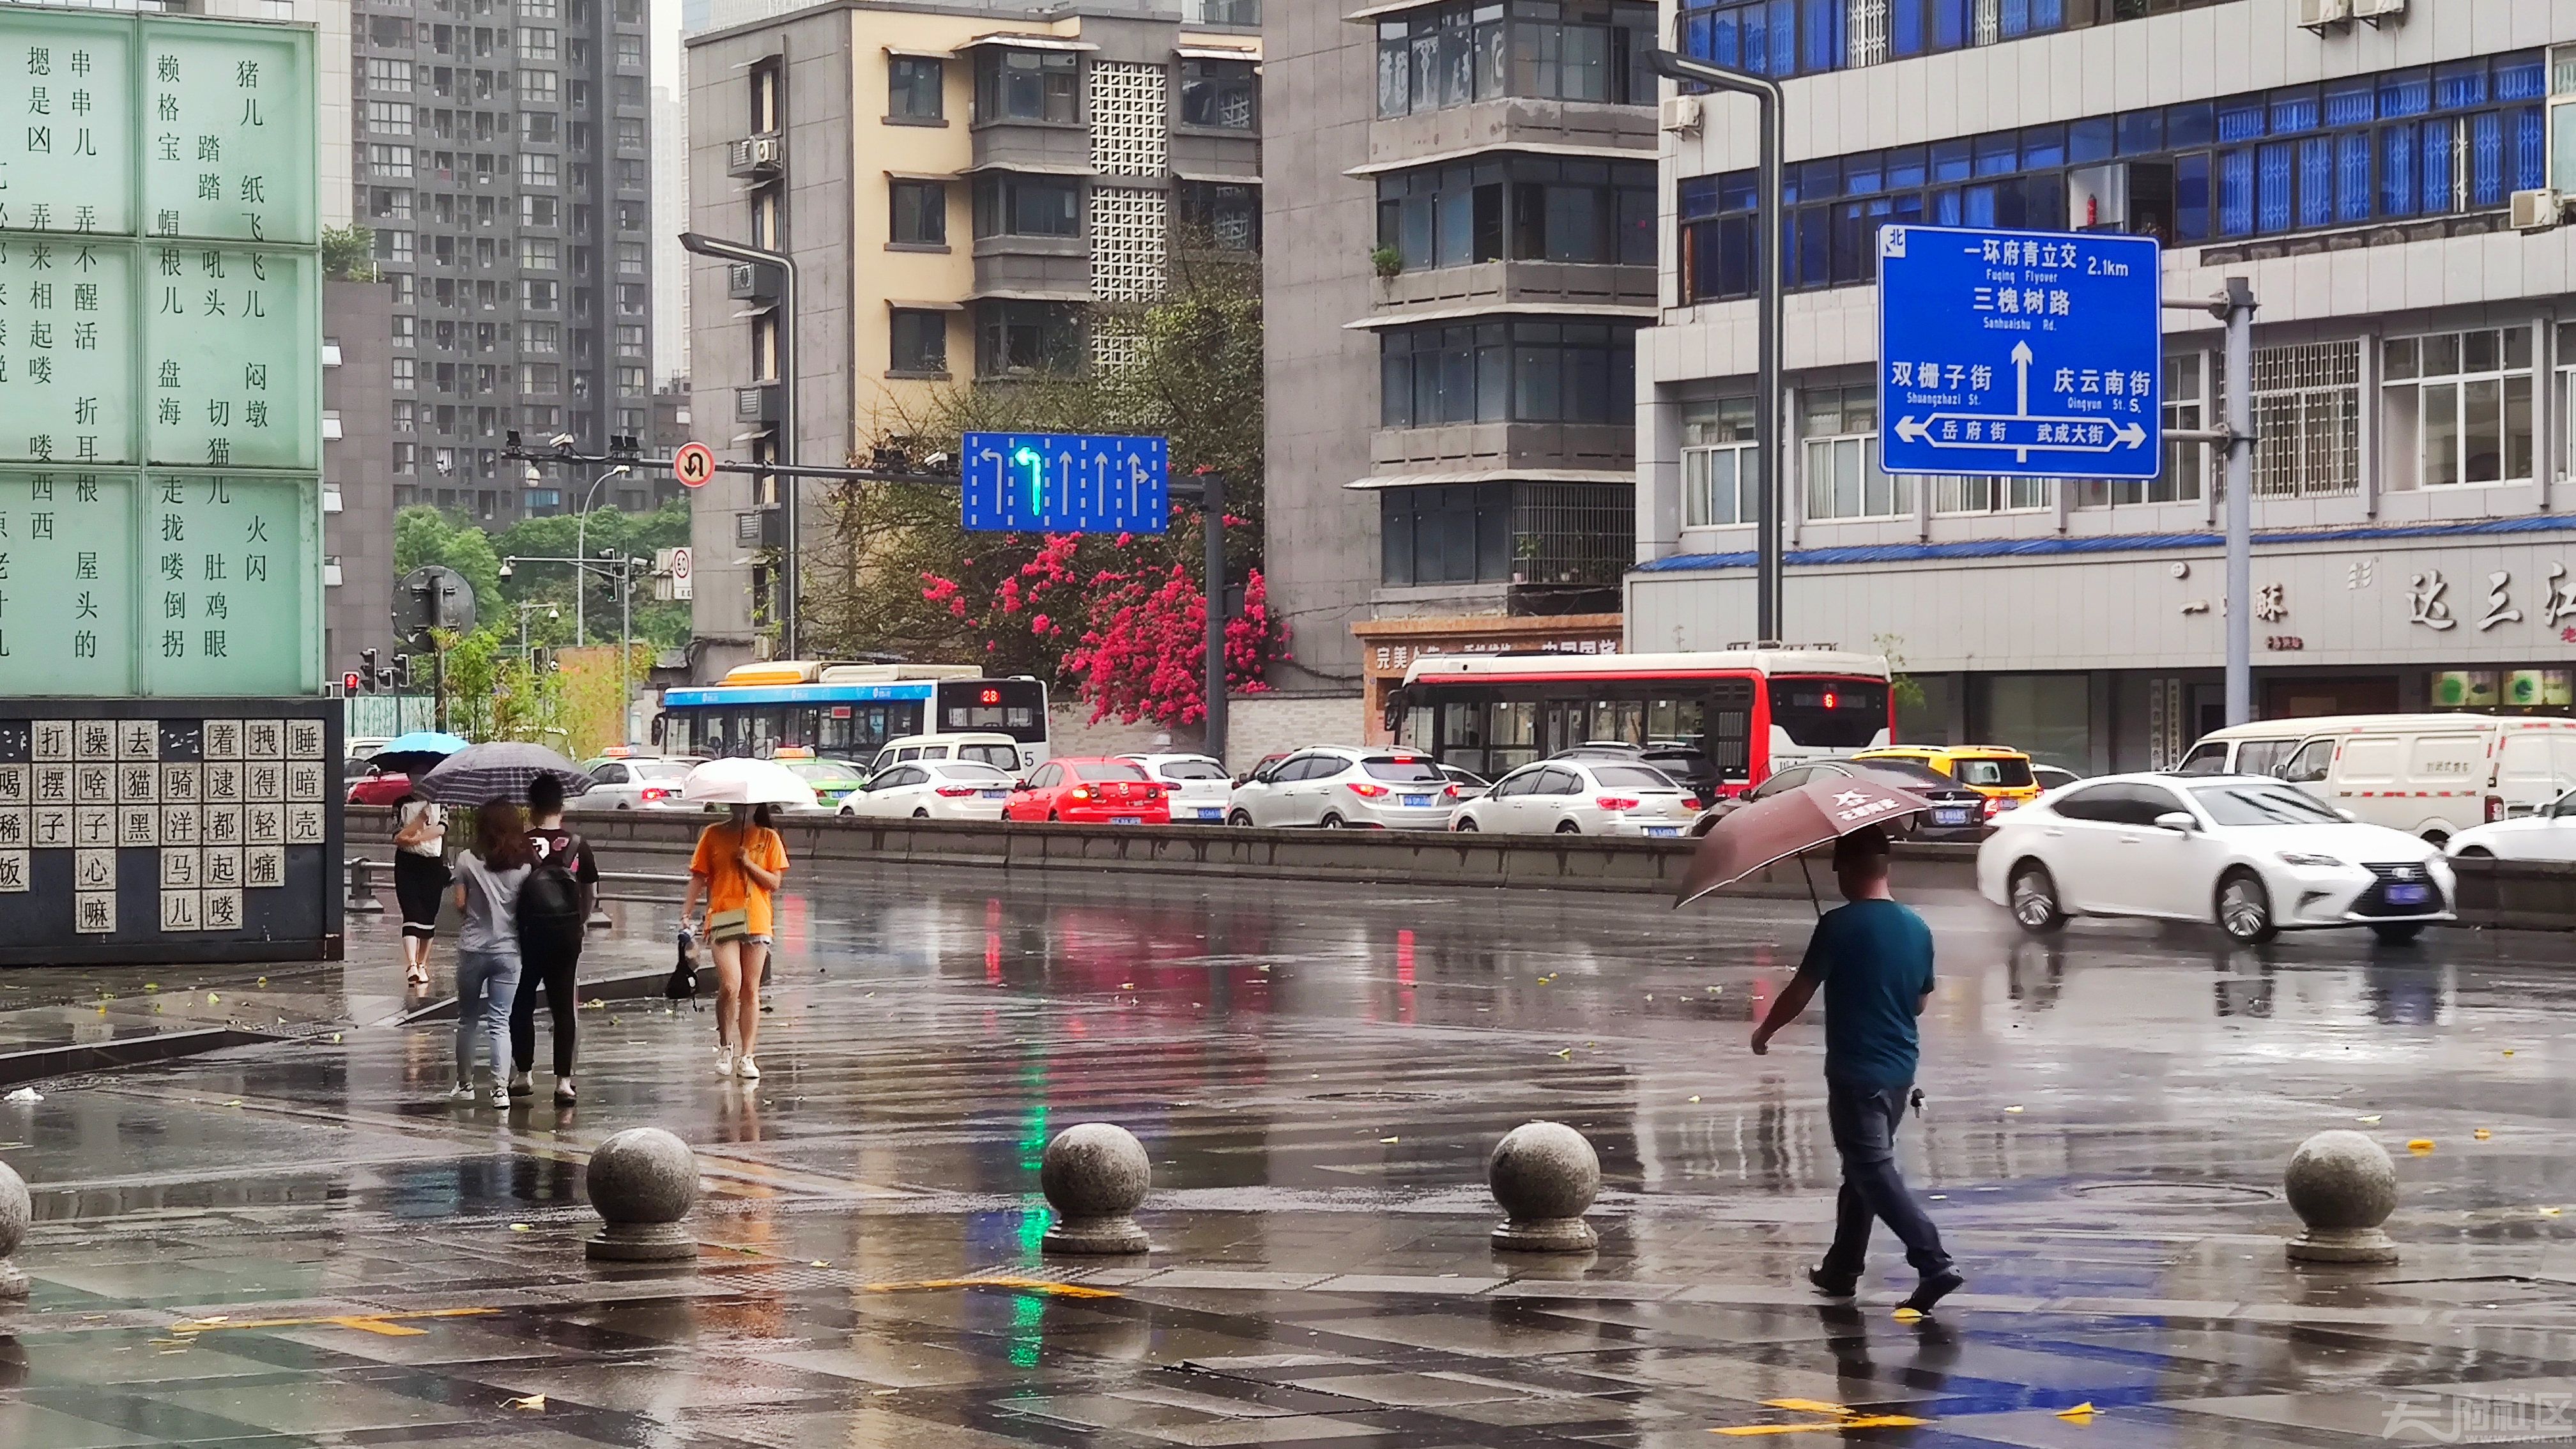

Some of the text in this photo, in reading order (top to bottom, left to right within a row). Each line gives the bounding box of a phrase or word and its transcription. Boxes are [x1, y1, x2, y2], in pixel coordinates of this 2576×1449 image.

[1890, 228, 1903, 246] 北
[1964, 239, 2129, 277] 一环府青立交 2.1km
[2025, 270, 2058, 284] Flyover
[1973, 287, 2070, 316] 三槐树路
[1983, 317, 2031, 331] Sanhuaishu
[1891, 361, 1992, 391] 双栅子街
[2053, 367, 2151, 397] 庆云南街
[1942, 420, 2007, 441] 岳府街
[2037, 423, 2104, 445] 武成大街
[983, 690, 998, 702] 28
[1825, 694, 1834, 708] 6
